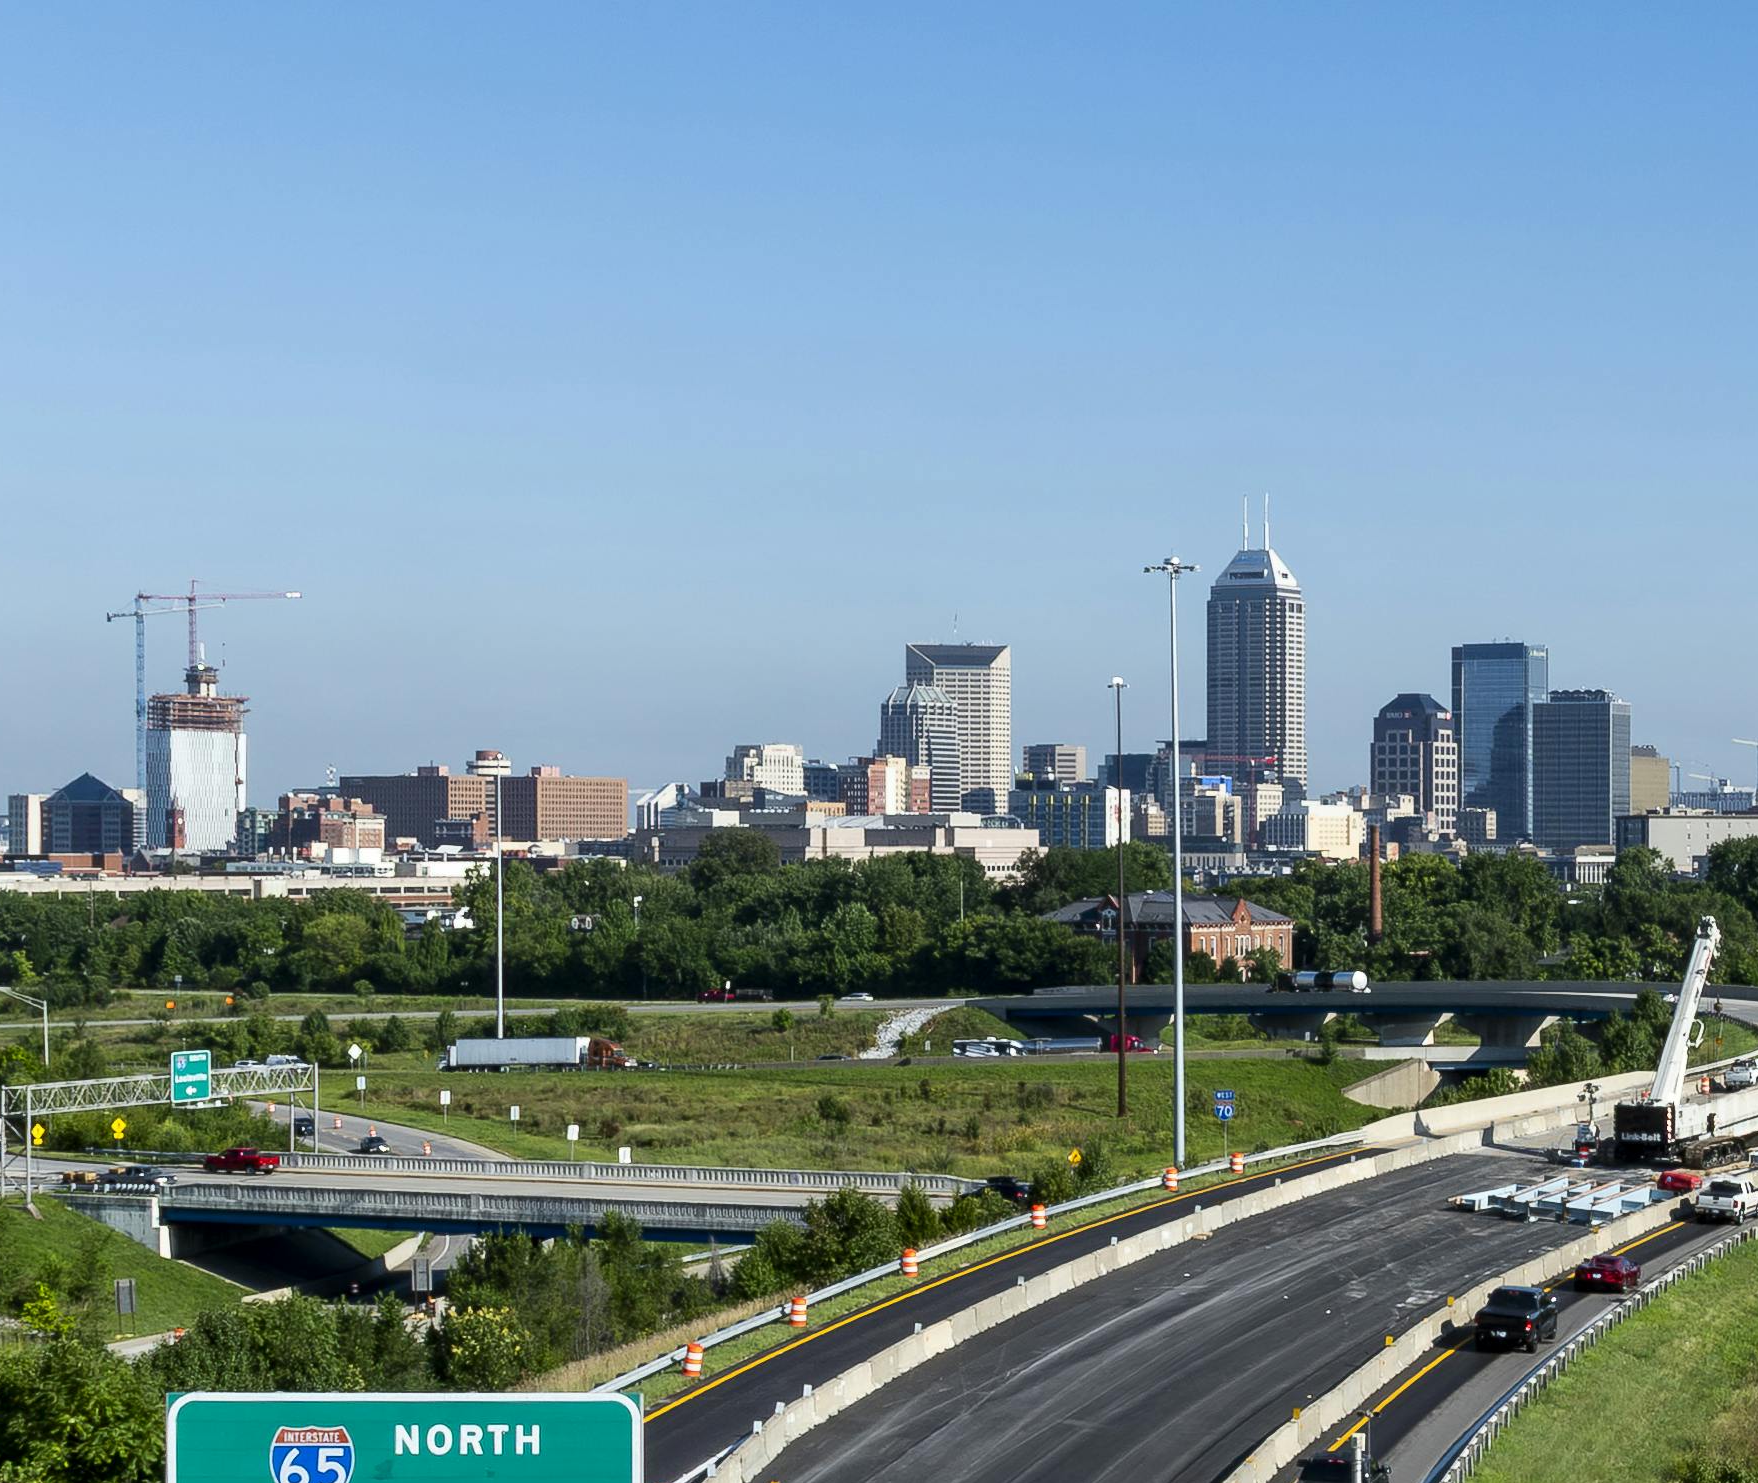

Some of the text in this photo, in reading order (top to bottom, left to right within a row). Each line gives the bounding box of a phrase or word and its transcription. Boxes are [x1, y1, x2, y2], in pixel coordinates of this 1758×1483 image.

[1216, 1105, 1234, 1118] 70
[1621, 1132, 1662, 1142] Link-Belt
[283, 1431, 340, 1444] INTERSTATE
[395, 1423, 541, 1456] NORTH
